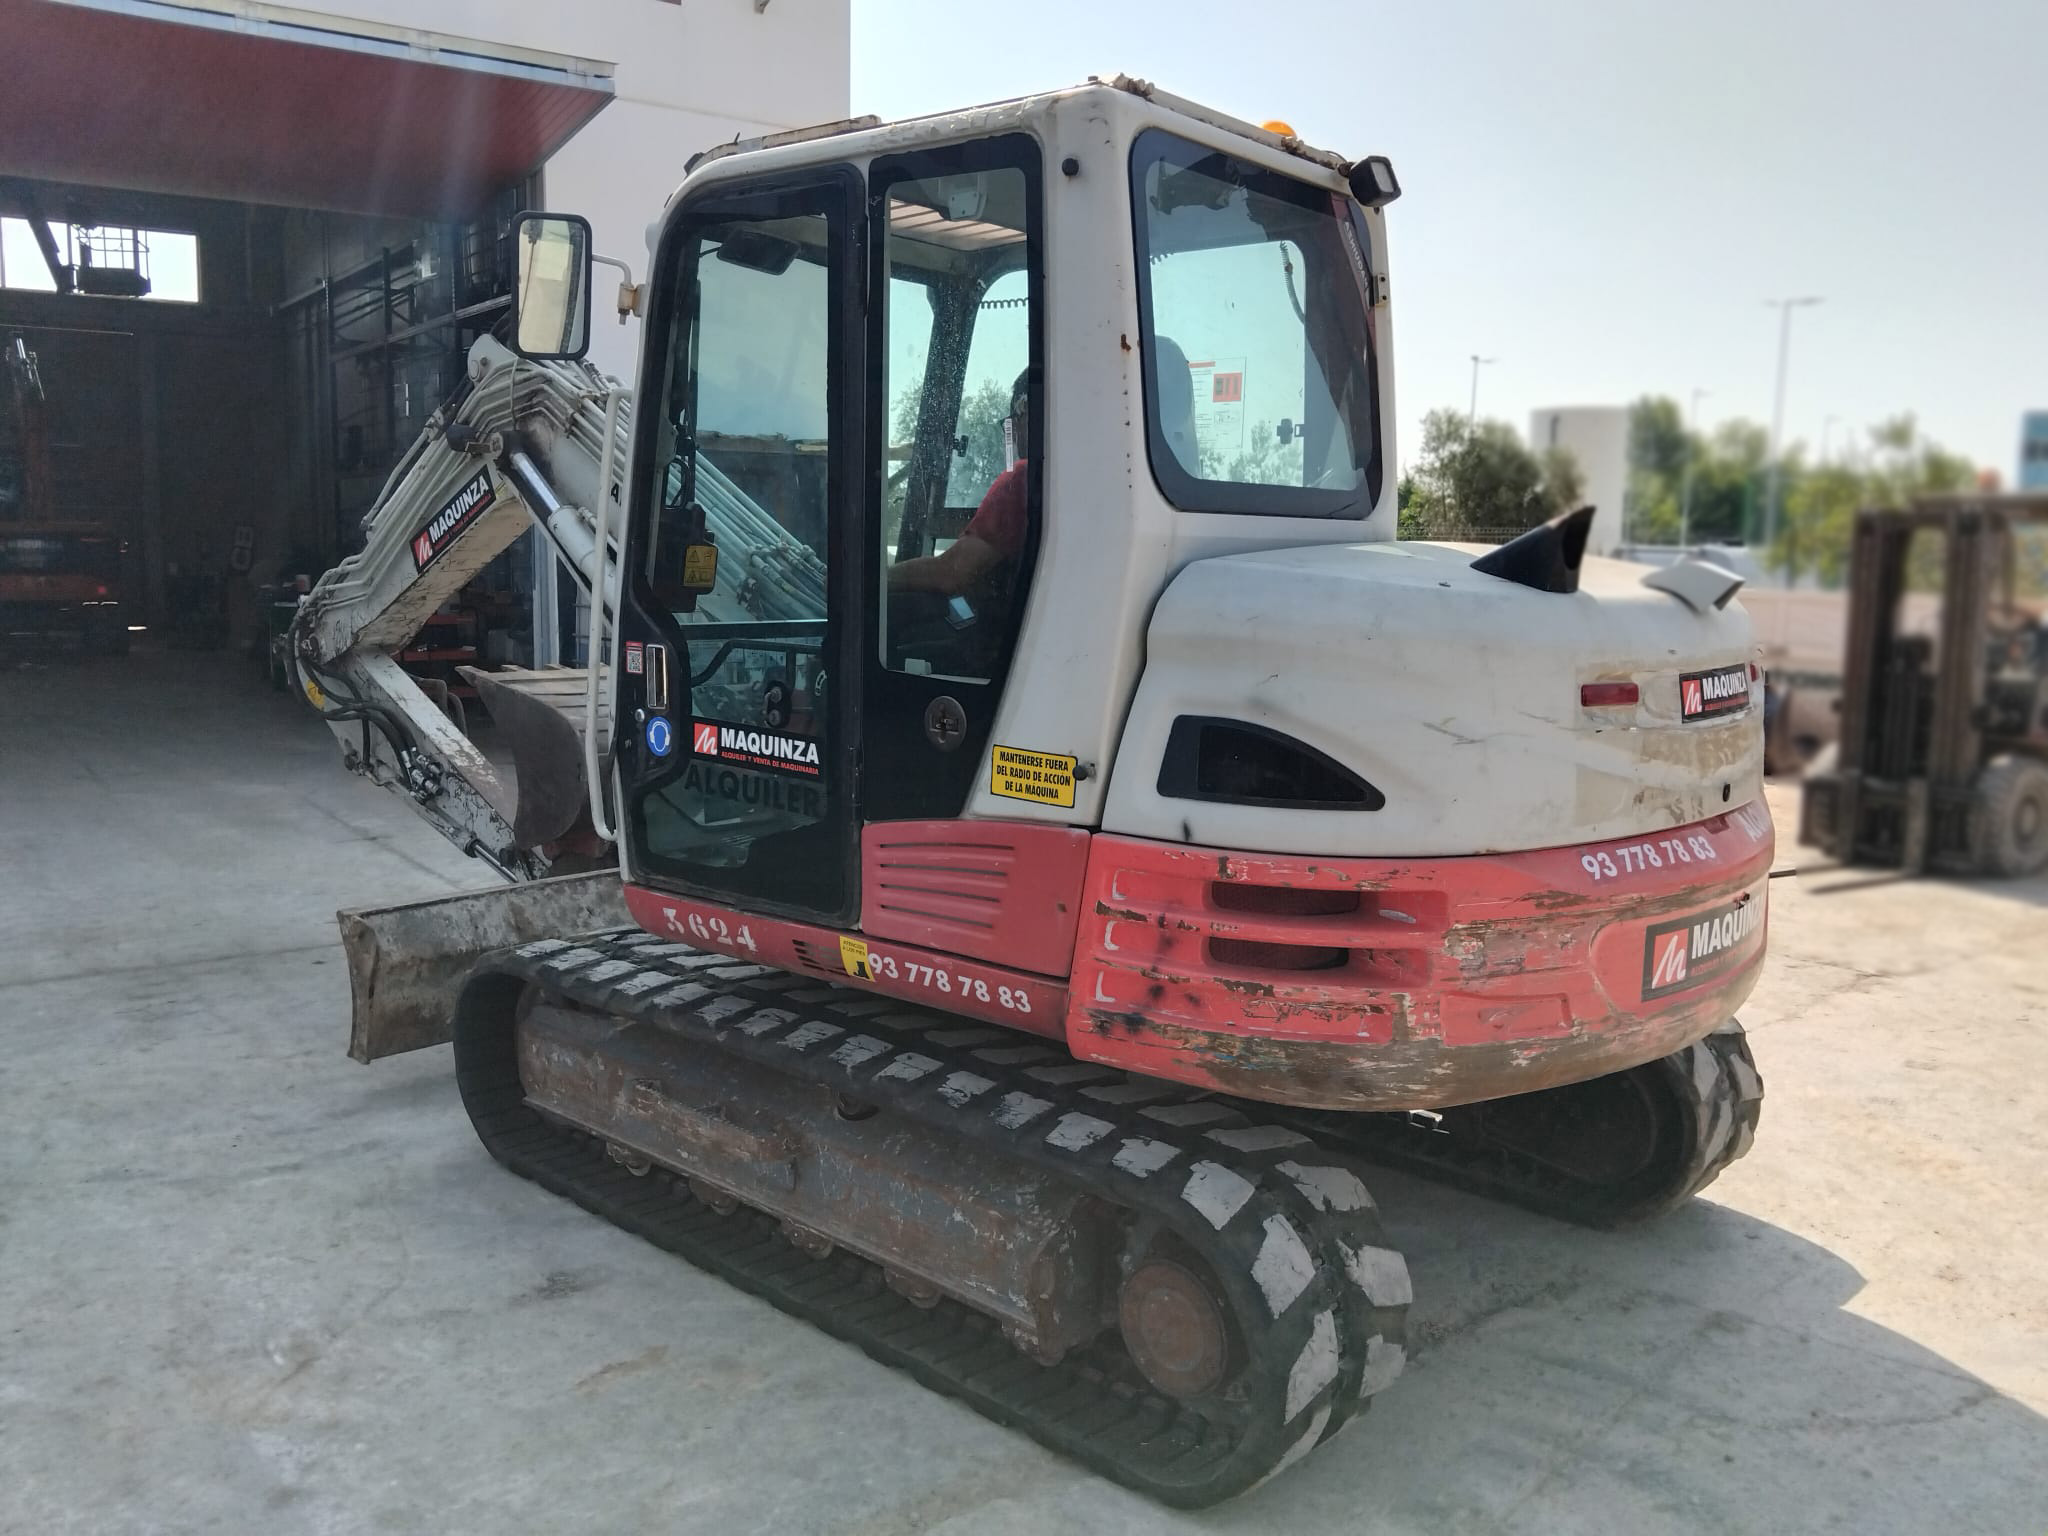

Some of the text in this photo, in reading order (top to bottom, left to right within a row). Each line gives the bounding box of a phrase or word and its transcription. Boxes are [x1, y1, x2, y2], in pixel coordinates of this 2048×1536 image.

[429, 475, 489, 543] MAQUINZA
[1702, 671, 1747, 700] MAQUINZA
[721, 728, 820, 764] MAQUINZA
[1000, 751, 1068, 772] MANTENERSE FUERA
[753, 757, 771, 766] VENTA
[772, 760, 780, 768] DE
[997, 765, 1008, 776] DEL
[1010, 767, 1031, 780] RADIO
[1033, 770, 1041, 782] DE
[684, 764, 819, 817] ALQUILER
[1005, 780, 1013, 791] DE
[1015, 782, 1022, 793] LA
[1581, 835, 1716, 880] 93 778 78 83
[867, 952, 1032, 1014] 93 778 78 83
